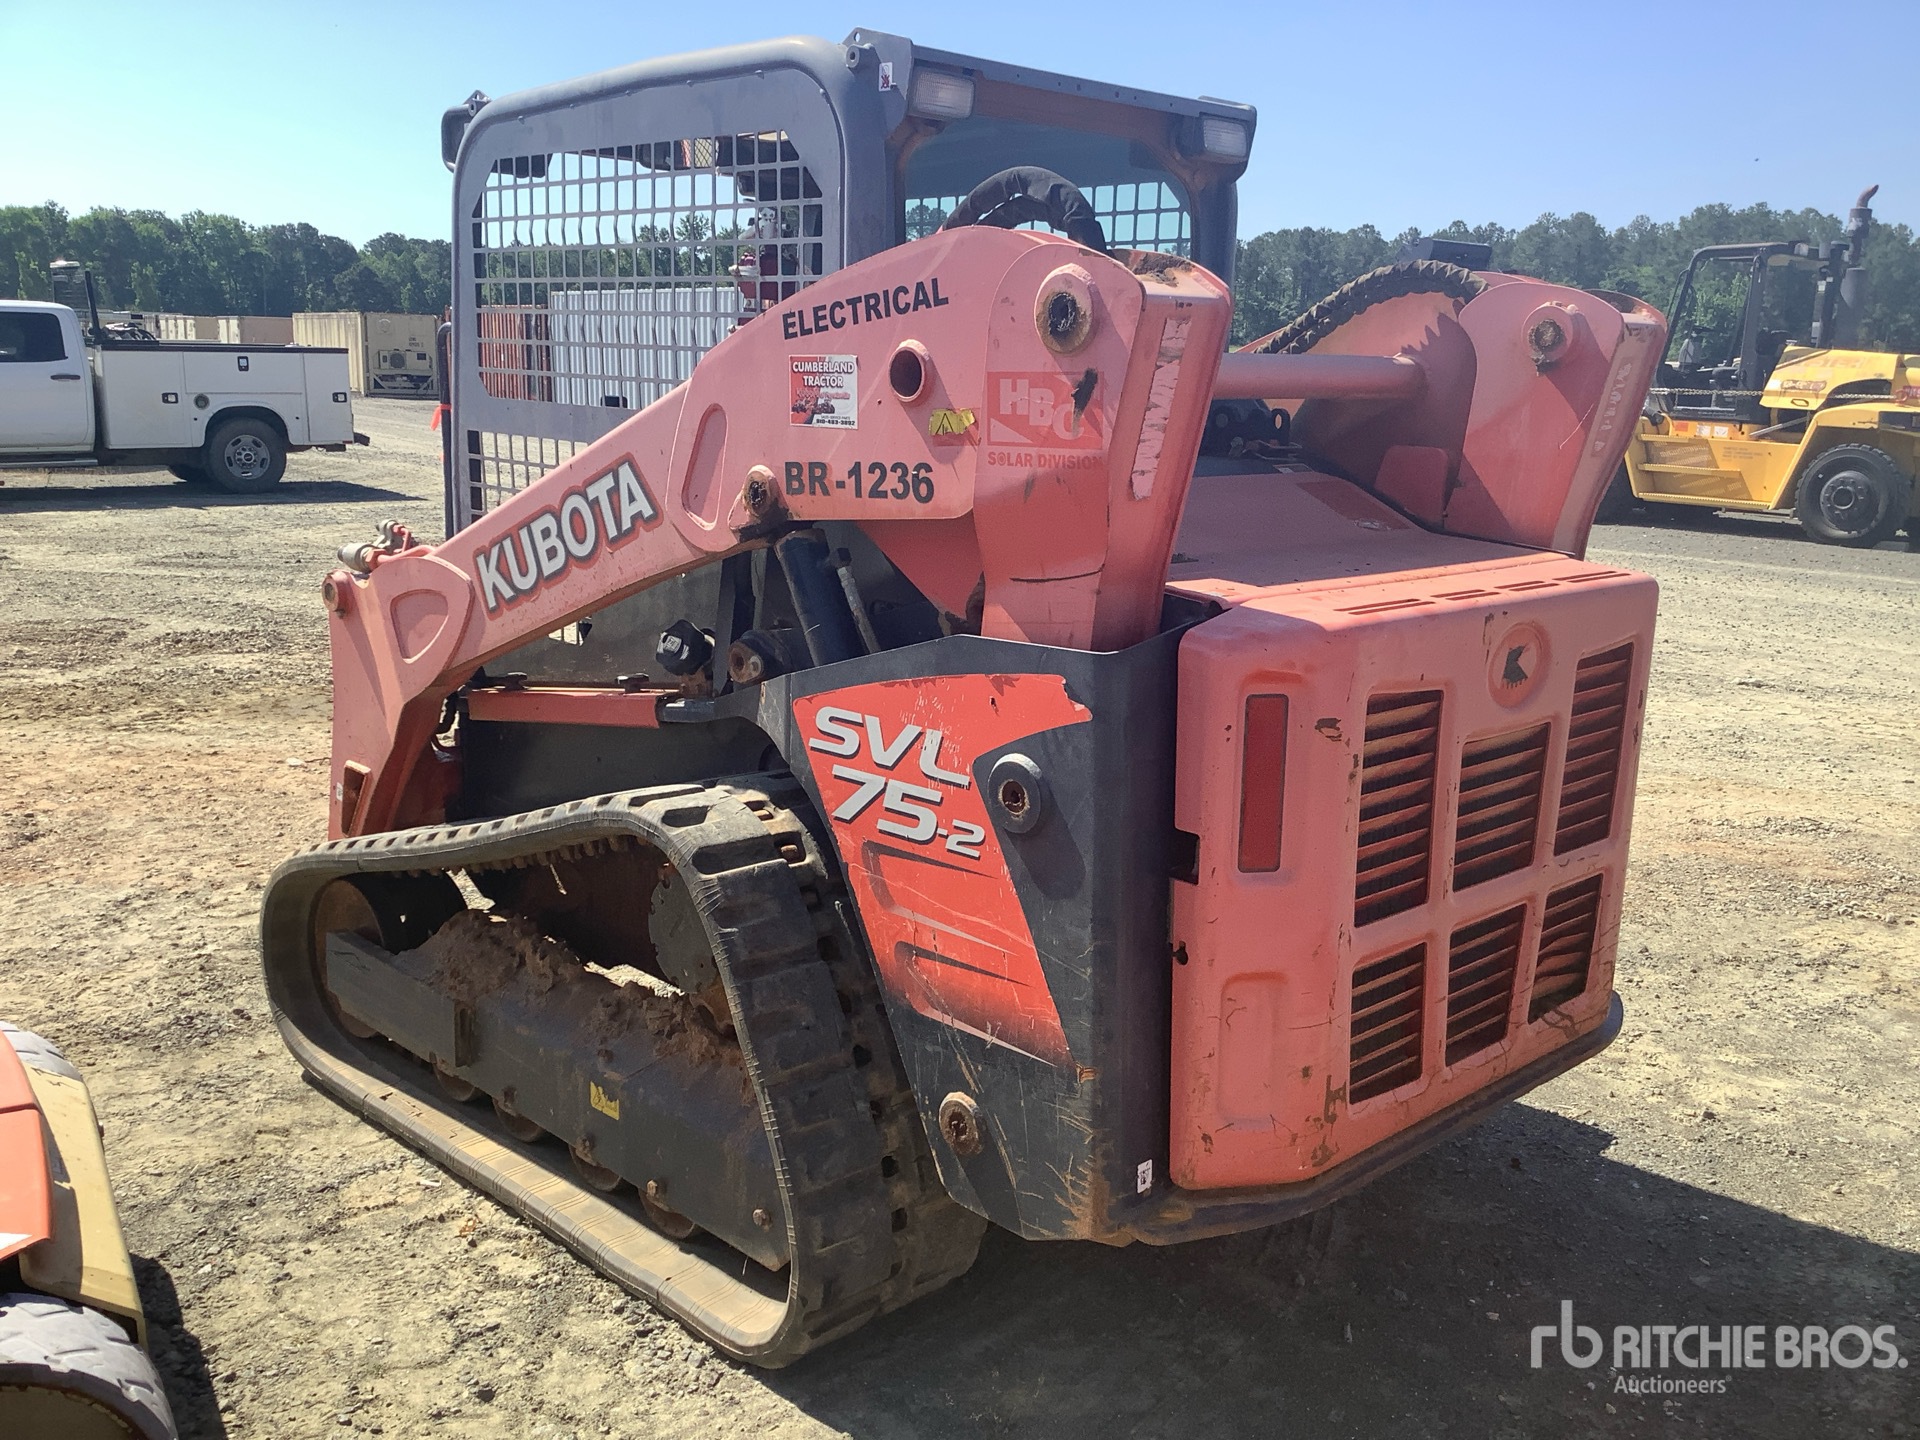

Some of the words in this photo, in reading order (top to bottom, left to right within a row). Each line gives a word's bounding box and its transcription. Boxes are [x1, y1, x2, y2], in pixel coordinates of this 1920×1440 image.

[782, 278, 949, 340] ELECTRICAL
[792, 361, 855, 374] CUMBERLAND
[802, 375, 844, 388] TRACTOR
[987, 451, 1033, 467] SOLAR
[1037, 453, 1103, 470] DIVISION
[784, 461, 935, 504] BR-1236
[475, 461, 654, 611] KUBOTA
[808, 706, 970, 788] SVL
